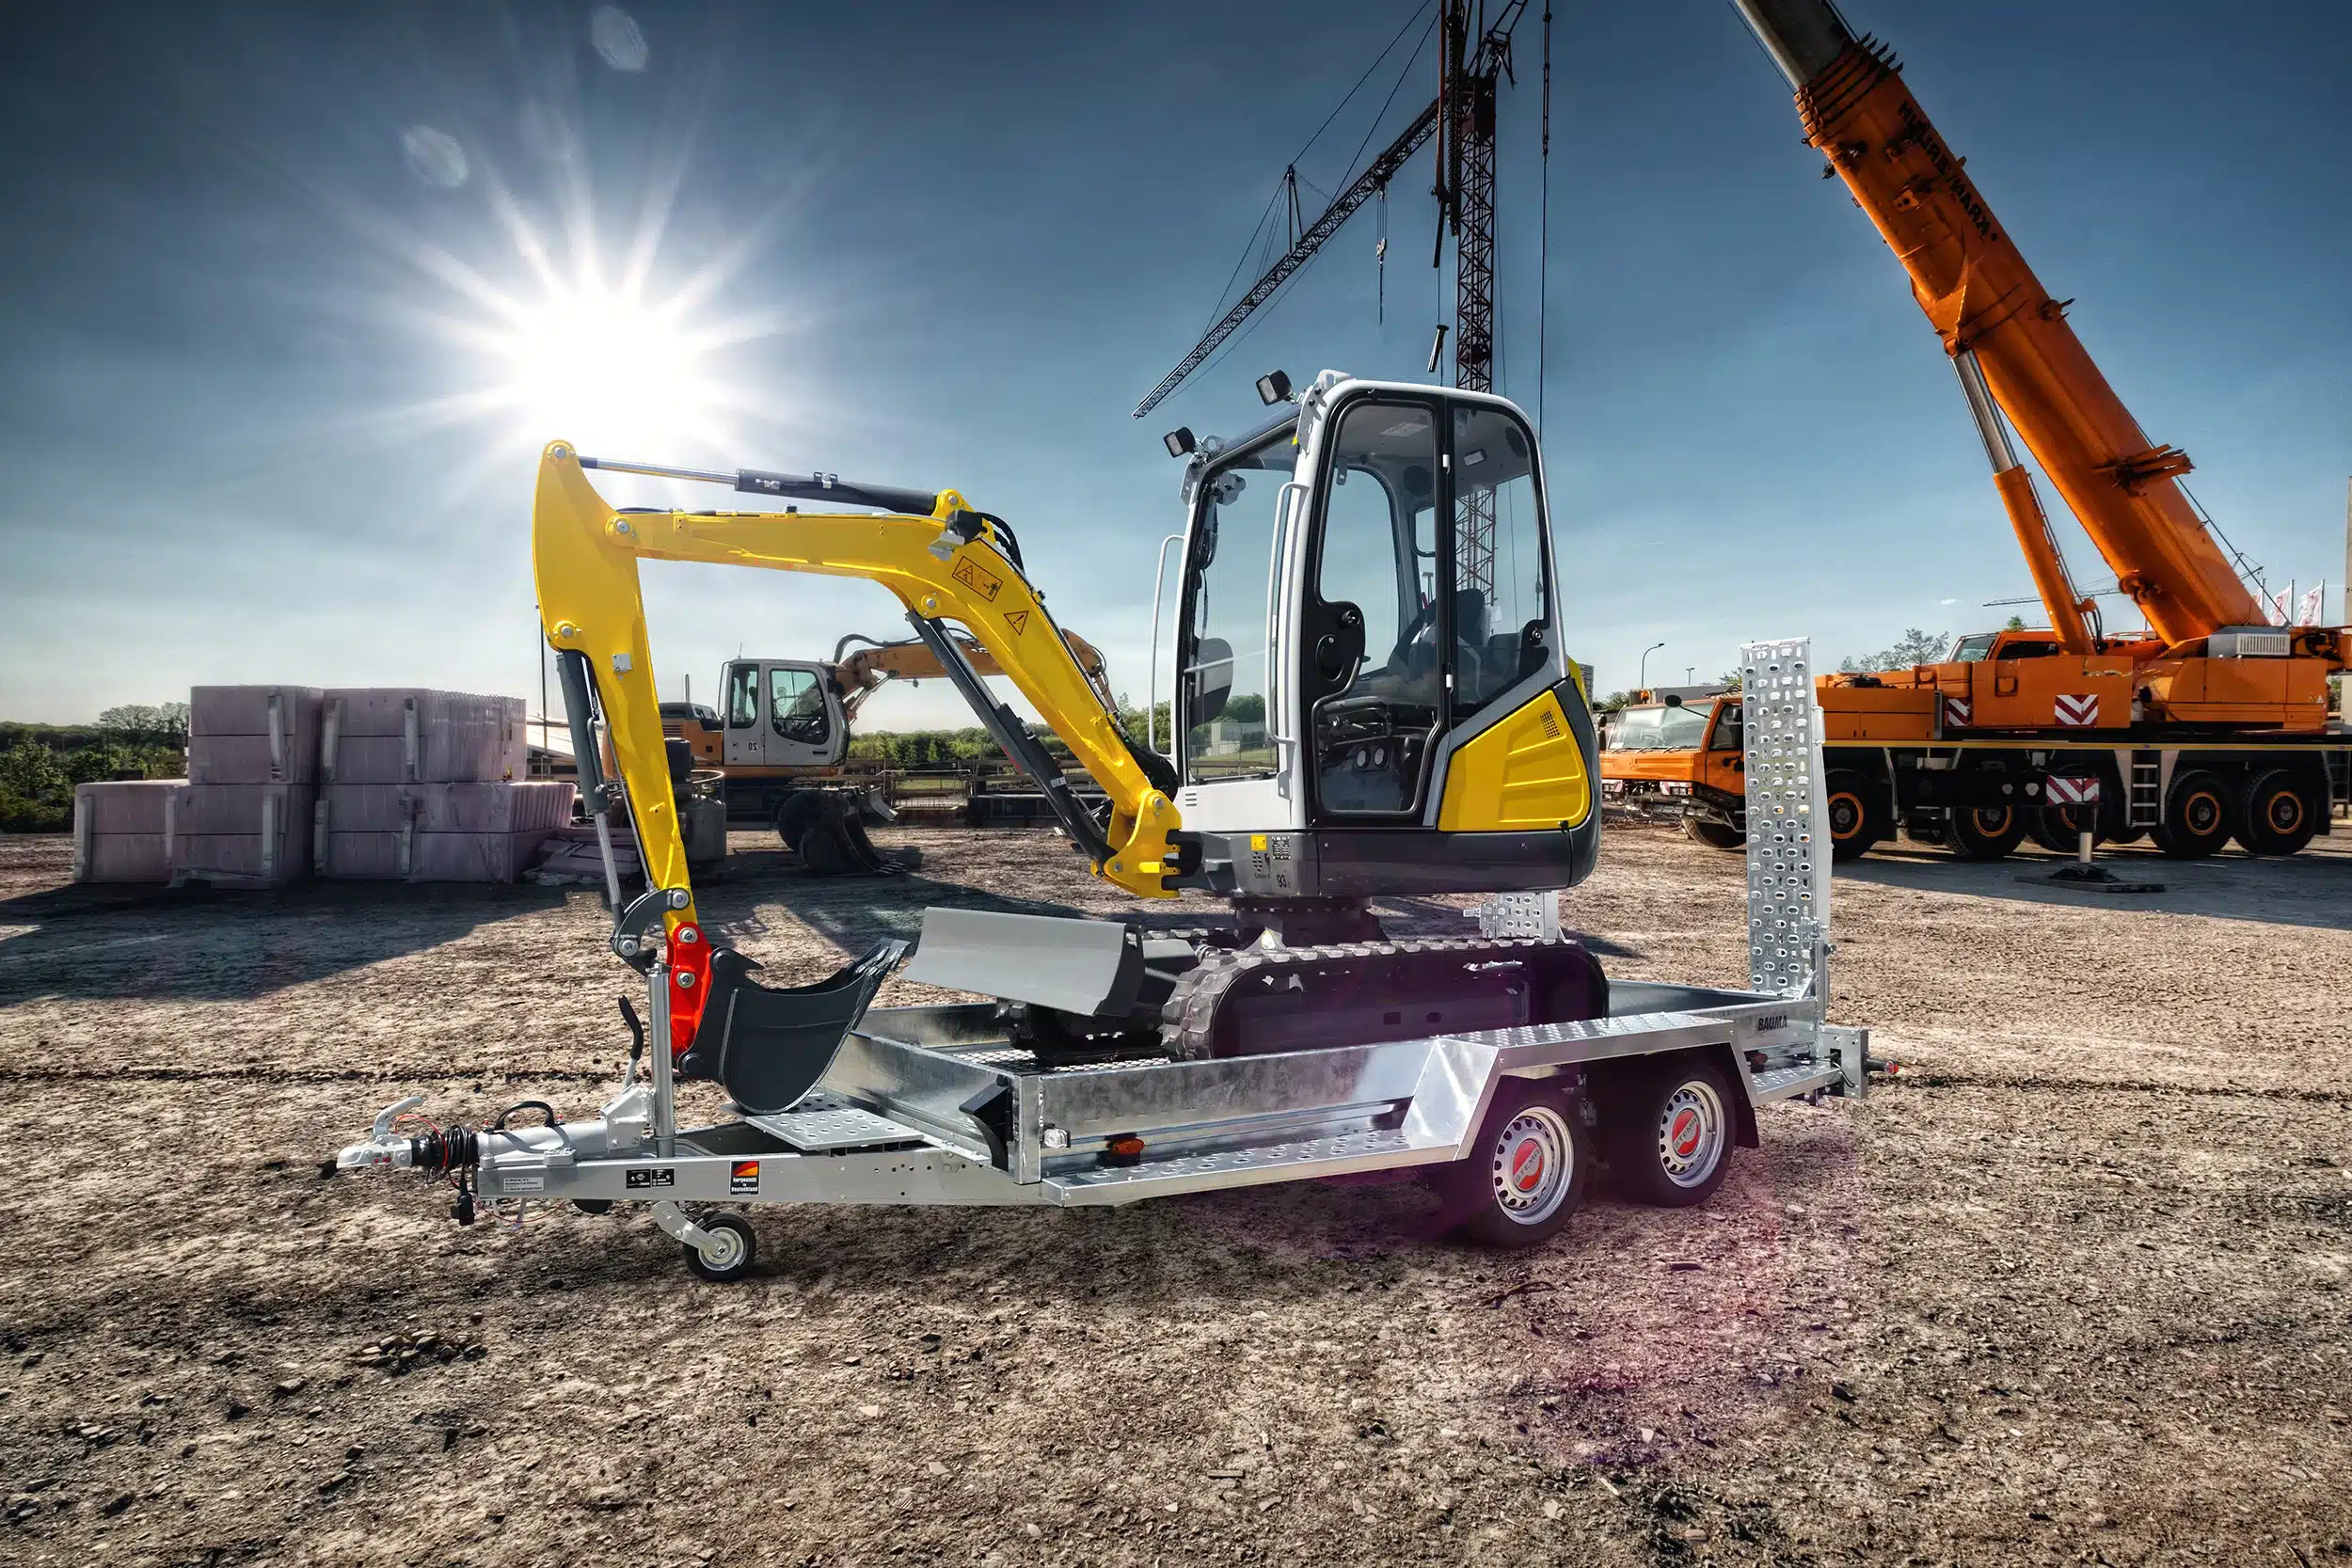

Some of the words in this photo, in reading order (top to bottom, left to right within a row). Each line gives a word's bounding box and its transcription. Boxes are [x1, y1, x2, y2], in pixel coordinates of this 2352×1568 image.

[1277, 874, 1287, 888] 93
[1758, 1015, 1788, 1031] BAUMA
[1674, 1117, 1697, 1148] STEMA
[1516, 1149, 1541, 1183] STEMA
